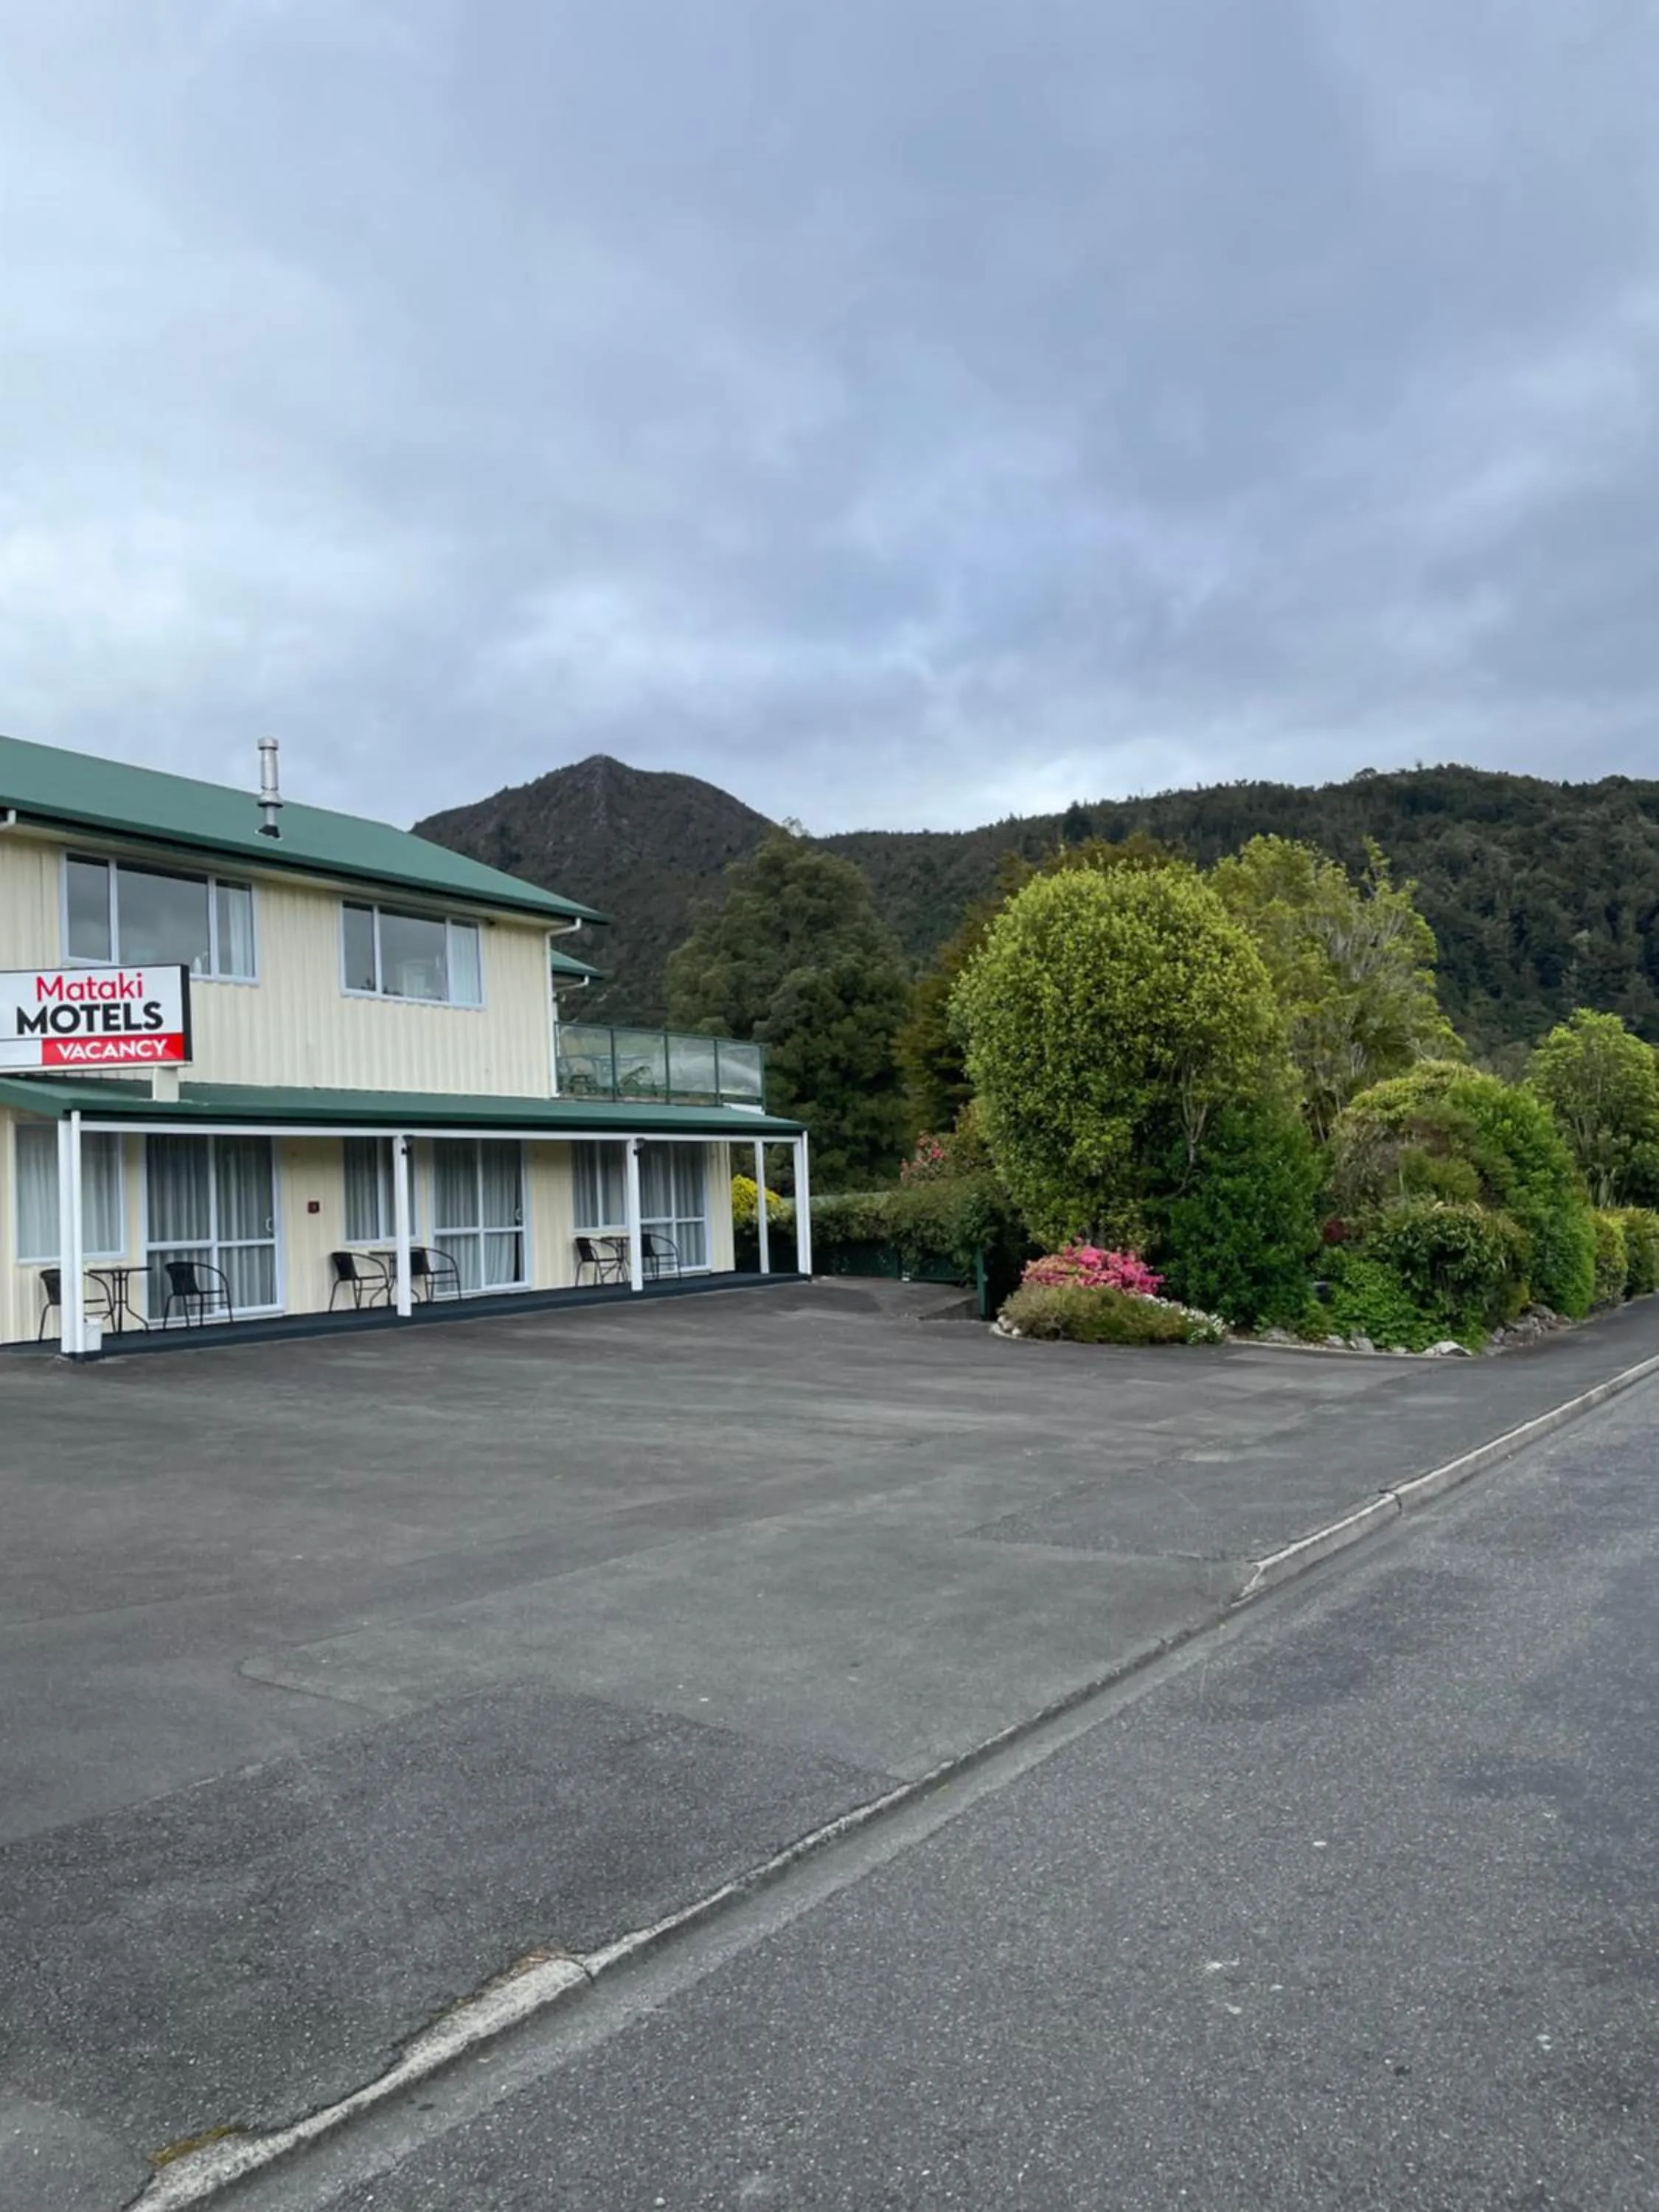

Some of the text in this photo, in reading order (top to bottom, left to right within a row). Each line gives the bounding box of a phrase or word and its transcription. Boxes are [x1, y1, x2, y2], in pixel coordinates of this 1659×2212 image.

[36, 972, 143, 1002] Mataki
[16, 1001, 164, 1035] MOTELS
[56, 1039, 167, 1060] VACANCY
